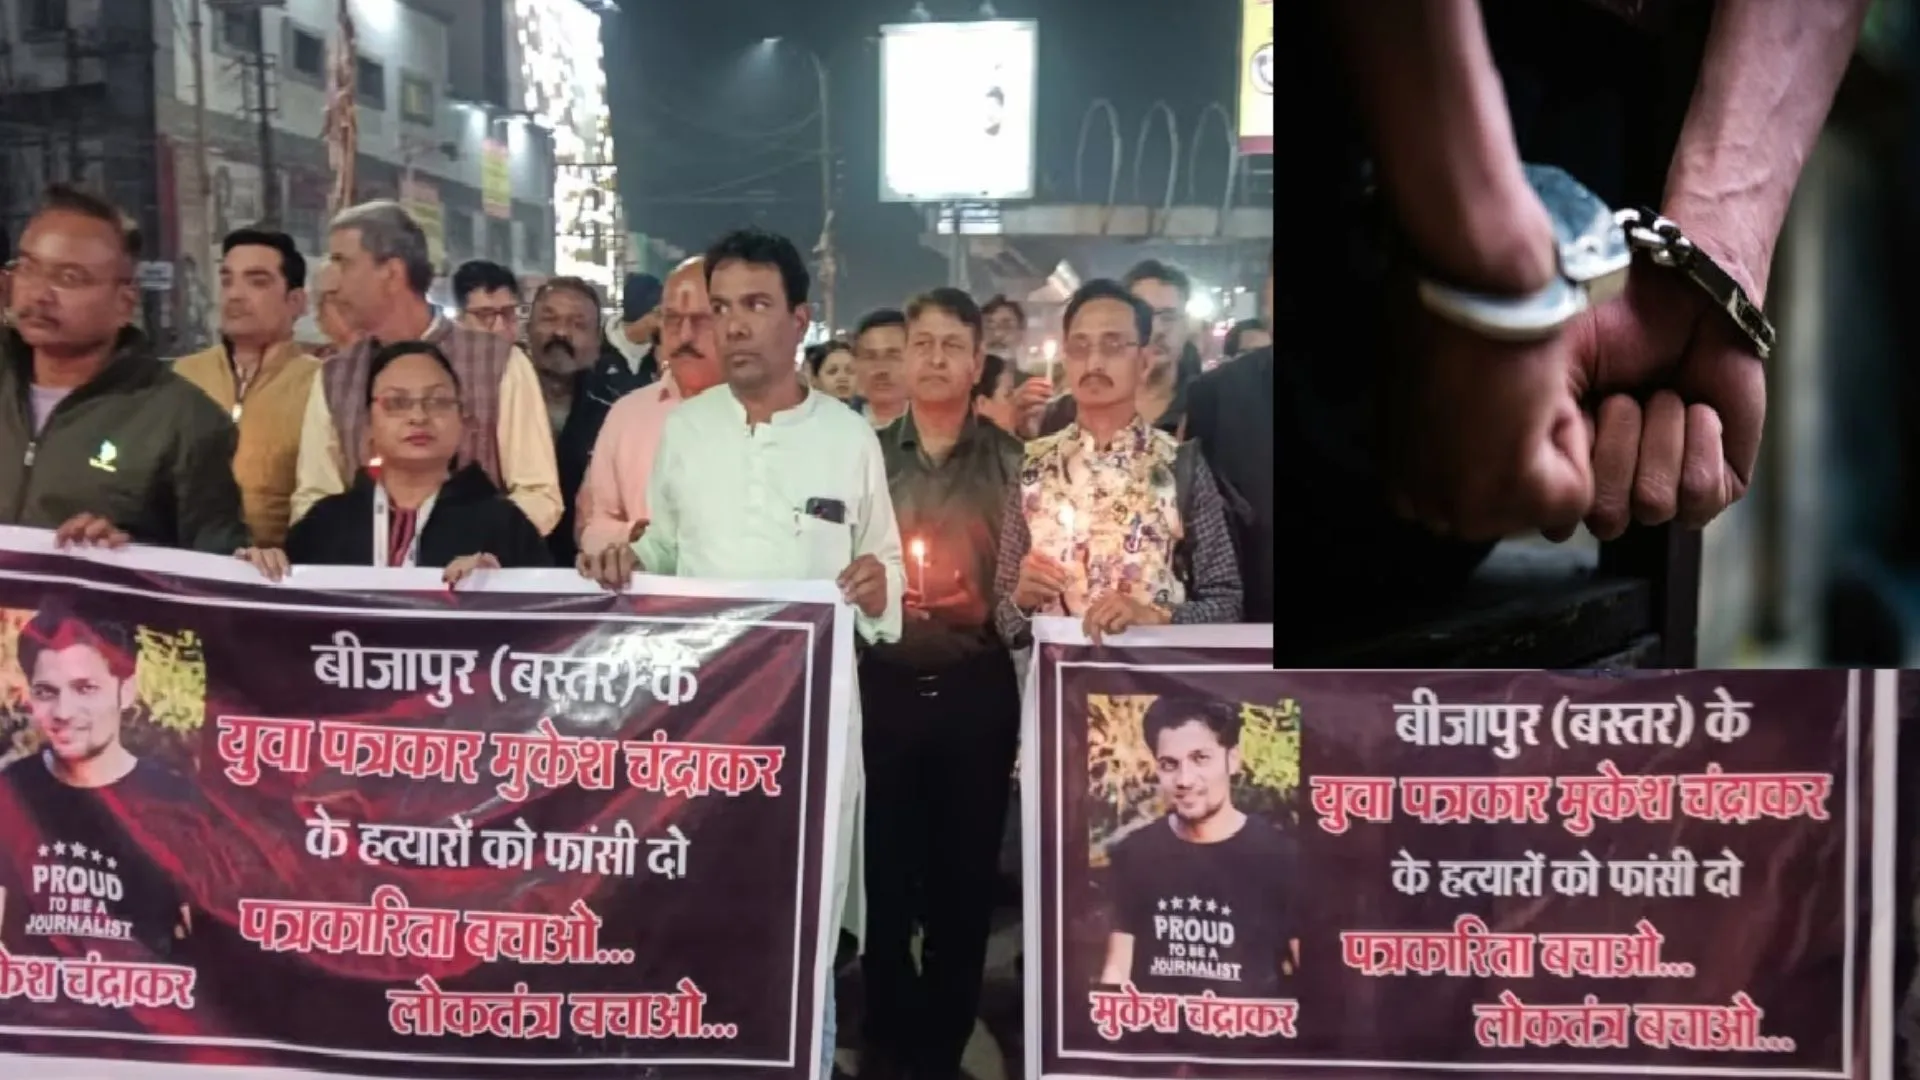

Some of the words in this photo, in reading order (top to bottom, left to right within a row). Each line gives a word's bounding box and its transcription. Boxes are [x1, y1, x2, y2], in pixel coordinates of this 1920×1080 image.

[310, 630, 478, 708] बीजापुर
[490, 643, 635, 708] (बस्तर)
[1394, 687, 1543, 759] बीजापुर
[1552, 695, 1693, 751] (बस्तर)
[1705, 687, 1752, 744] के
[217, 714, 314, 786] युवा
[320, 720, 486, 786] पत्रकार
[490, 716, 620, 802] मुकेश
[622, 729, 784, 797] चंद्राकर
[1310, 774, 1396, 834] युवा
[1401, 774, 1551, 826] पत्रकार
[1555, 760, 1674, 836] मुकेश
[1680, 762, 1832, 824] चंद्राकर
[305, 804, 349, 857] के
[358, 814, 476, 868] हत्यारों
[481, 818, 536, 870] को
[544, 819, 639, 876] फांसी
[646, 826, 691, 879] दो
[34, 865, 124, 900] PROUD
[1391, 848, 1430, 898] के
[1438, 852, 1544, 899] हत्यारों
[1550, 852, 1600, 898] को
[1609, 847, 1699, 898] फांसी
[1703, 849, 1743, 899] दो
[26, 914, 134, 939] JOURNALIST
[97, 900, 107, 914] A
[238, 884, 457, 958] पत्रकारिता
[1155, 917, 1235, 947] PROUD
[1150, 959, 1241, 982] JOURNALIST
[1209, 946, 1219, 960] A
[1340, 914, 1534, 978] पत्रकारिता
[62, 950, 196, 1009] चंद्राकर
[387, 976, 562, 1038] लोकतंत्र
[1088, 980, 1179, 1041] मुकेश
[1184, 989, 1298, 1039] चंद्राकर
[1472, 990, 1629, 1048] लोकतंत्र
